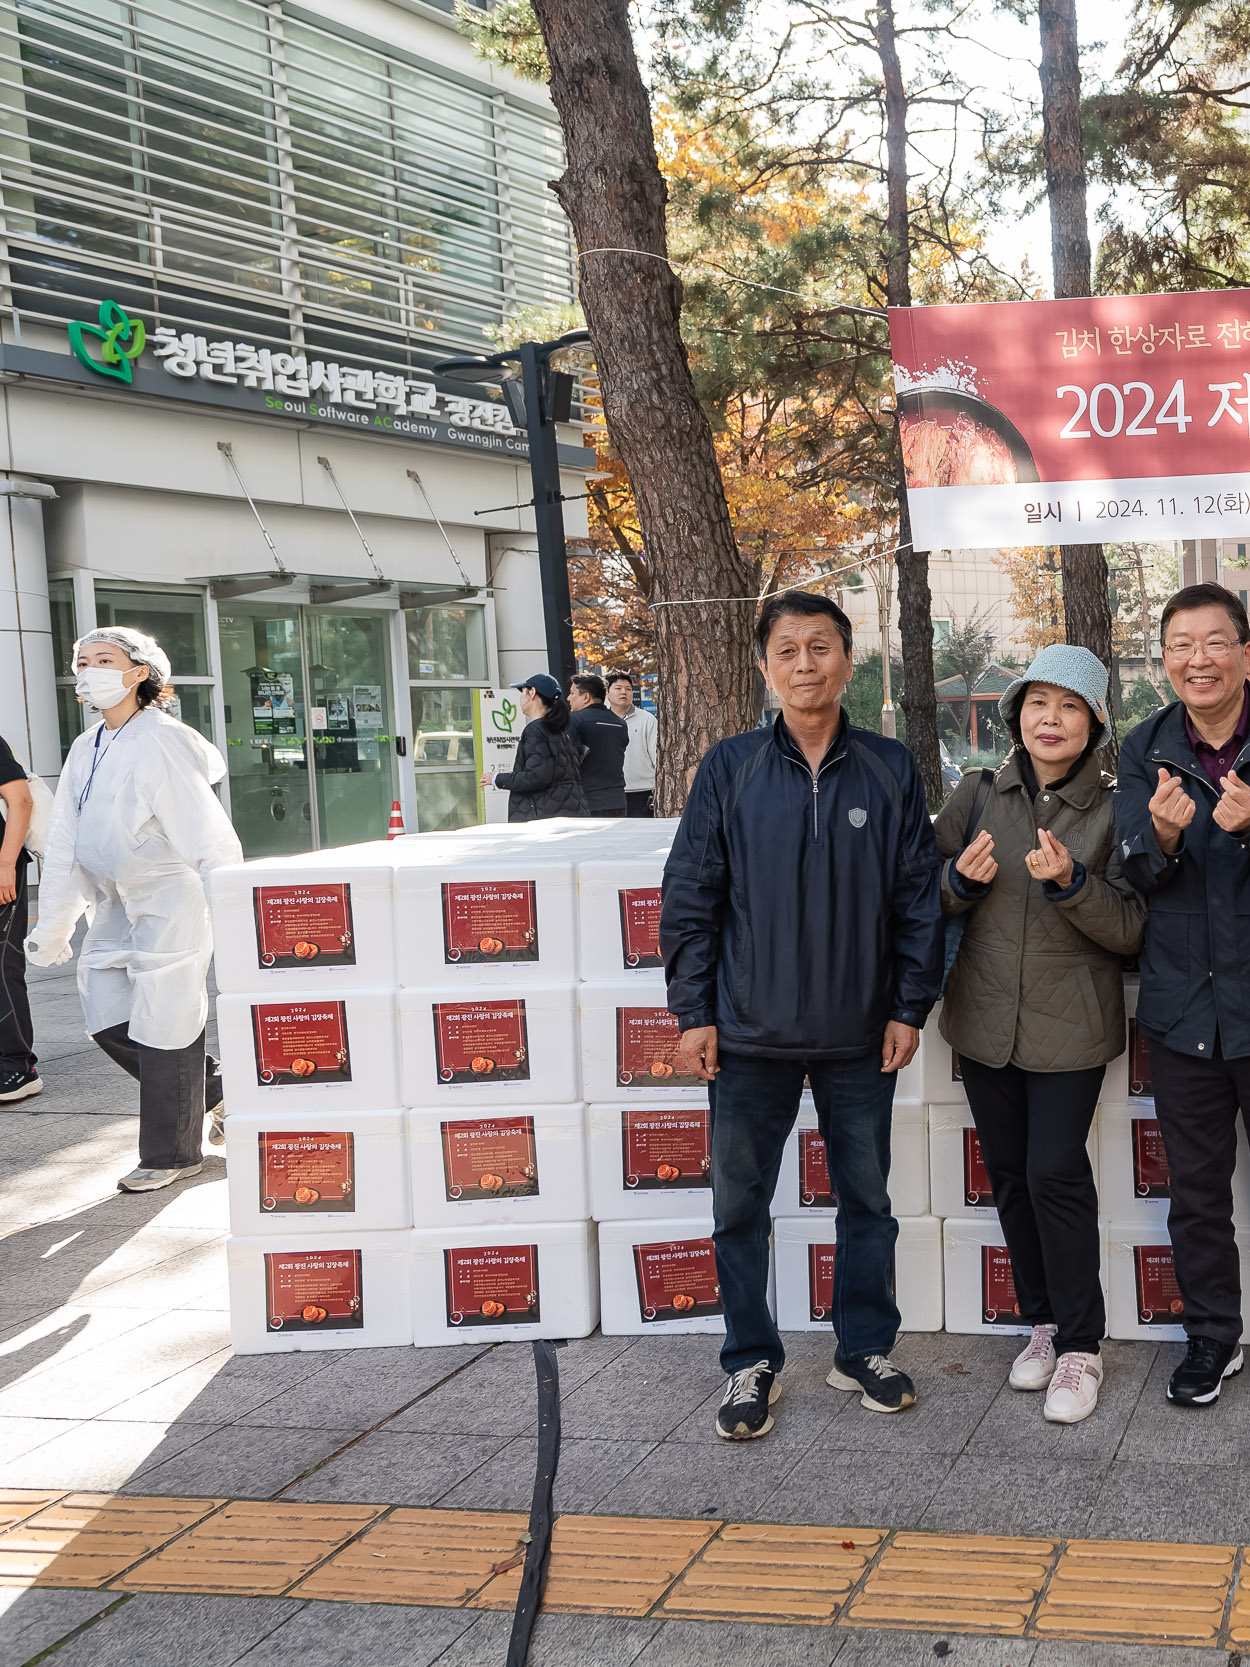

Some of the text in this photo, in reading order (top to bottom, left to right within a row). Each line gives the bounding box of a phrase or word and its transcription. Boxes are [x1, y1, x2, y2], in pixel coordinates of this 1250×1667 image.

[1055, 327, 1101, 358] 김치
[1107, 322, 1212, 356] 한상자로
[153, 327, 528, 437] 청년취업사관학교 광진캠
[1057, 378, 1192, 440] 2024
[265, 395, 307, 415] Seoul
[310, 402, 369, 426] Software
[374, 414, 438, 438] ACademy
[447, 428, 502, 449] Gwangjin
[1024, 500, 1062, 524] 일시
[1096, 498, 1149, 520] 2024.
[1158, 496, 1184, 517] 11.
